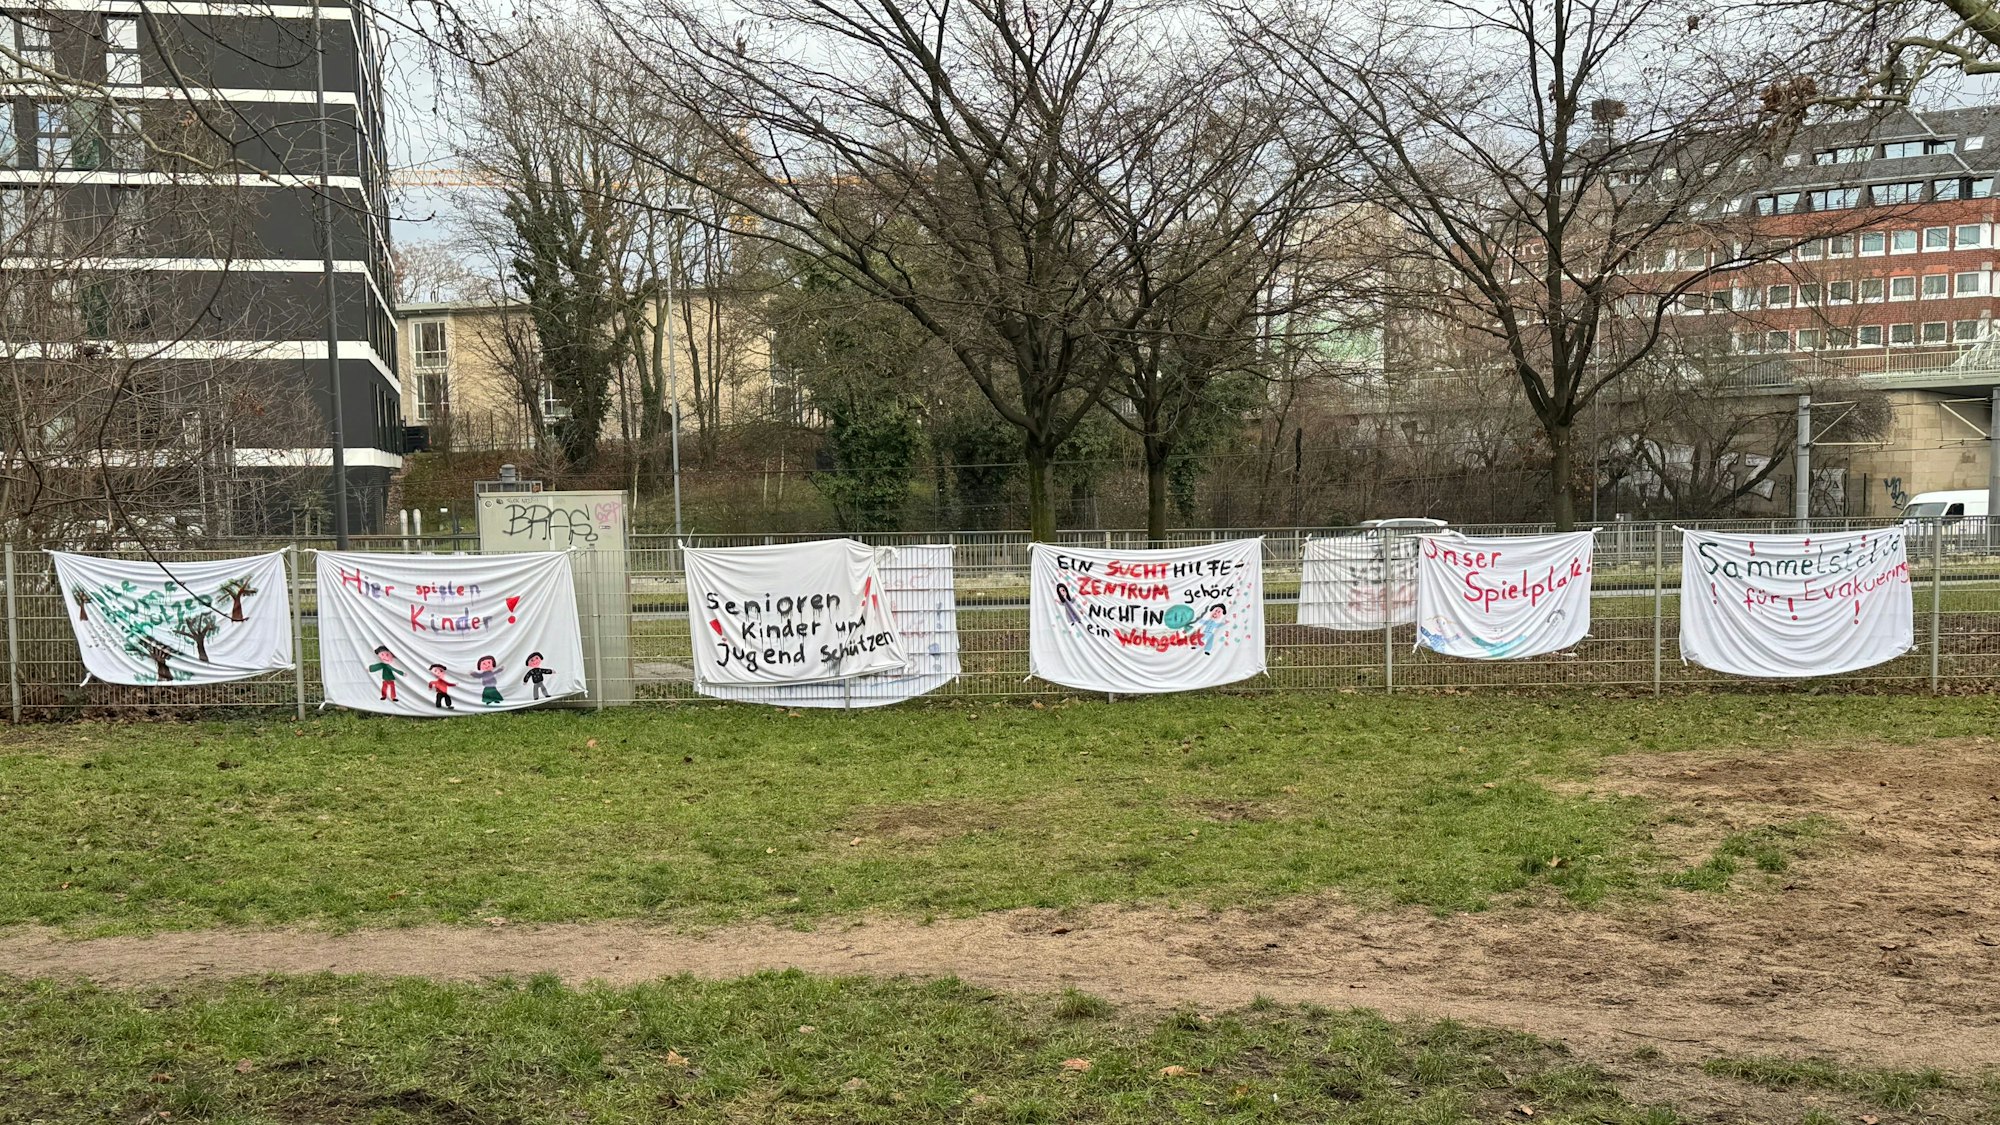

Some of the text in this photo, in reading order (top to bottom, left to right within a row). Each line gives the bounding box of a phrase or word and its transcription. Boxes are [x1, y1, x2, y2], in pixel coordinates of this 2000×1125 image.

[1057, 555, 1093, 573] EIN
[1423, 538, 1502, 569] Unser
[340, 567, 481, 602] Hier spielen
[1077, 576, 1235, 603] ZENTRUM gehört
[706, 592, 841, 617] Senioren
[1088, 603, 1141, 623] NICHT
[1743, 587, 1781, 613] für
[410, 604, 493, 633] Kinder
[742, 618, 821, 641] Kinder
[1087, 622, 1205, 652] ein Wohngebiet
[716, 643, 806, 672] Jugend
